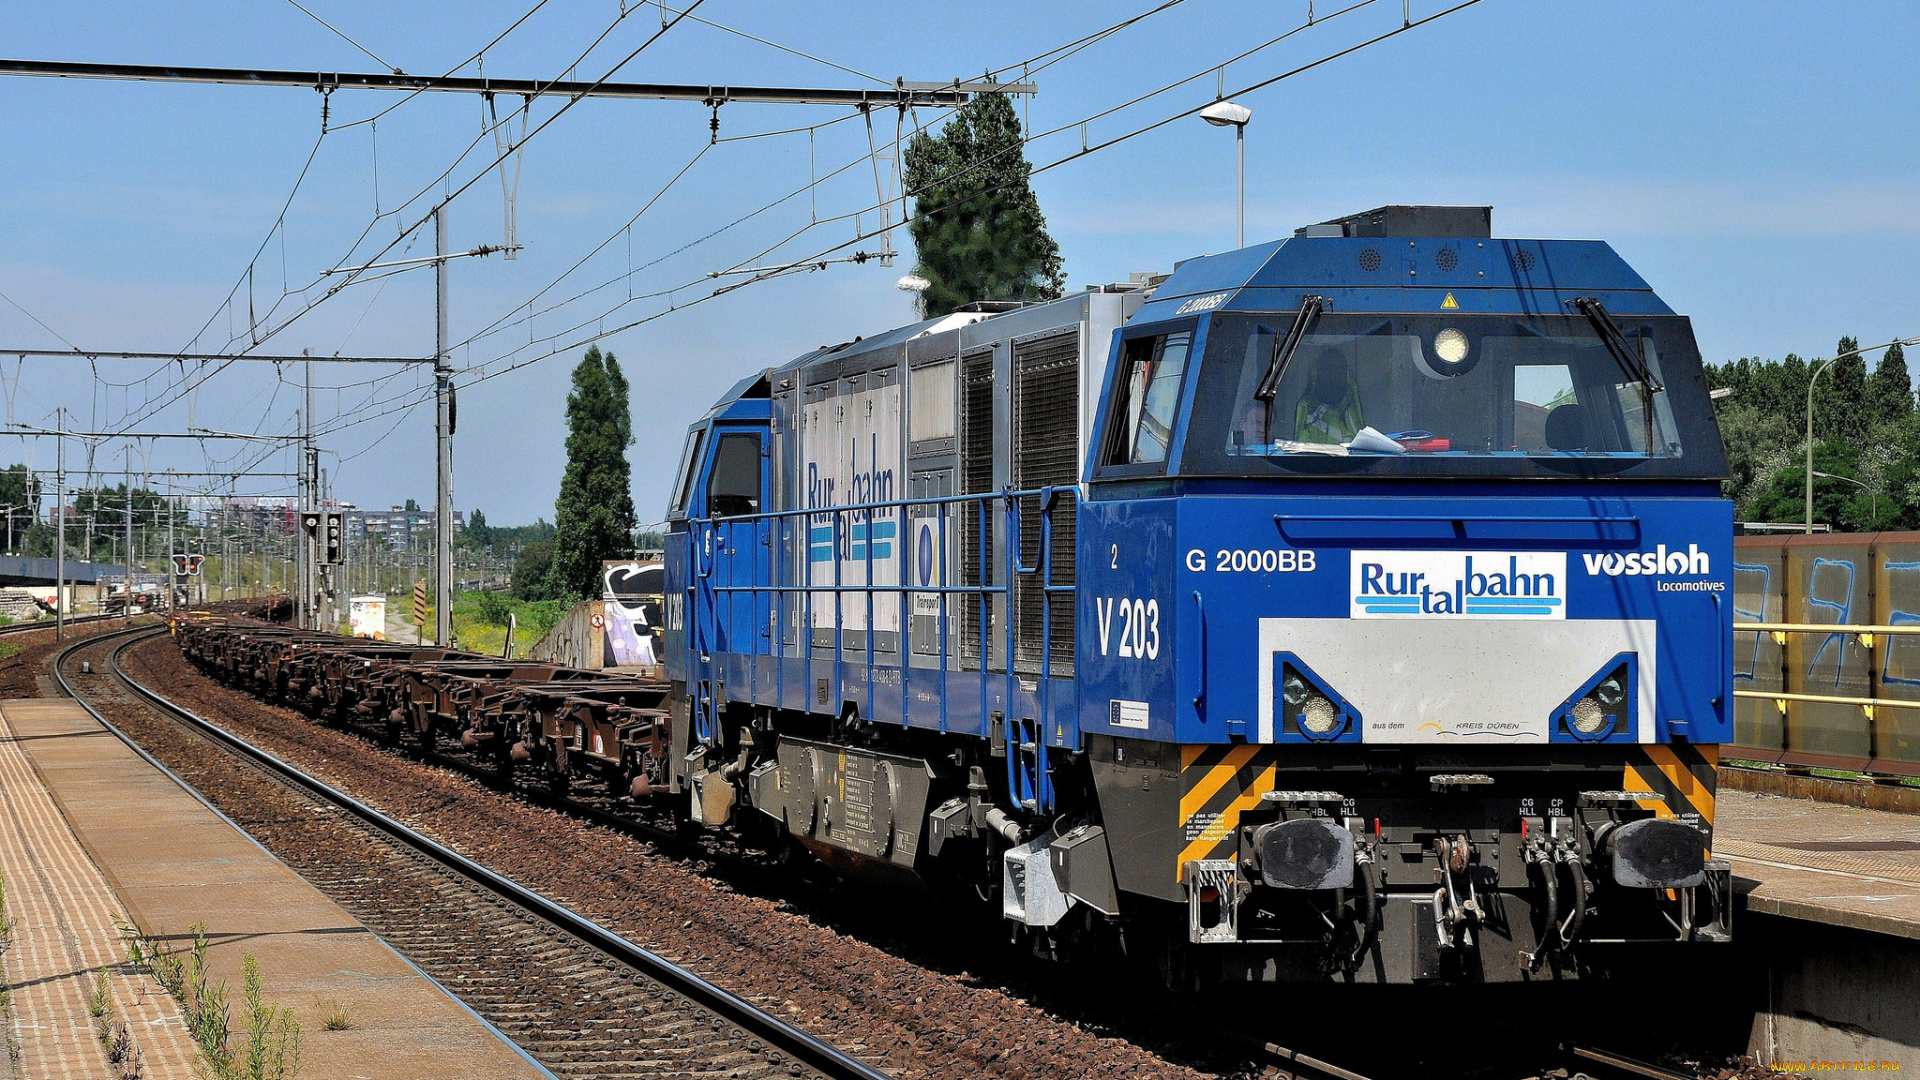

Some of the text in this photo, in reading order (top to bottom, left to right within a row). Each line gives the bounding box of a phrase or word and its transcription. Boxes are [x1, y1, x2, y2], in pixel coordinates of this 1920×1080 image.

[1111, 543, 1118, 570] 2
[1185, 548, 1316, 572] G 2000BB
[1582, 543, 1710, 576] vossloh
[1657, 579, 1726, 592] Locomotives
[1096, 597, 1160, 661] V 203
[1456, 721, 1520, 730] KREIS DÜREN
[1343, 798, 1355, 806] CG
[1521, 798, 1534, 807] CG
[1551, 798, 1563, 807] CP
[1340, 807, 1358, 816] HLL
[1519, 807, 1537, 816] HLL
[1548, 807, 1566, 817] HBL
